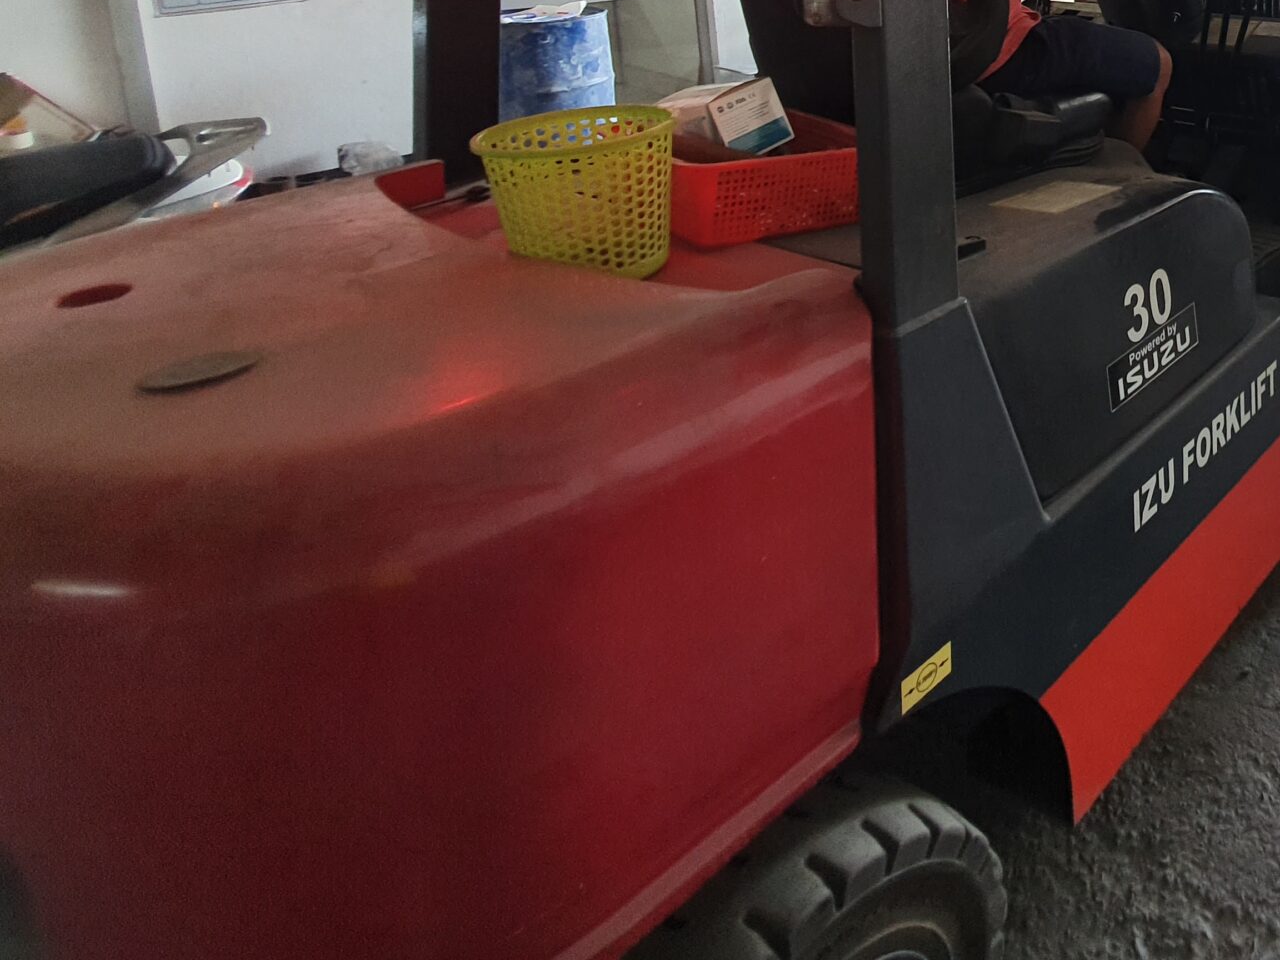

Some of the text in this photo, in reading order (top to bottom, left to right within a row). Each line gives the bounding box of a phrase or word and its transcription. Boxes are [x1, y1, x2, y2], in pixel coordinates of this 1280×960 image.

[1124, 268, 1172, 343] 30
[1117, 326, 1191, 401] ISUZU
[1129, 322, 1178, 366] Powered by
[1133, 360, 1278, 533] IZU FORKLIFT
